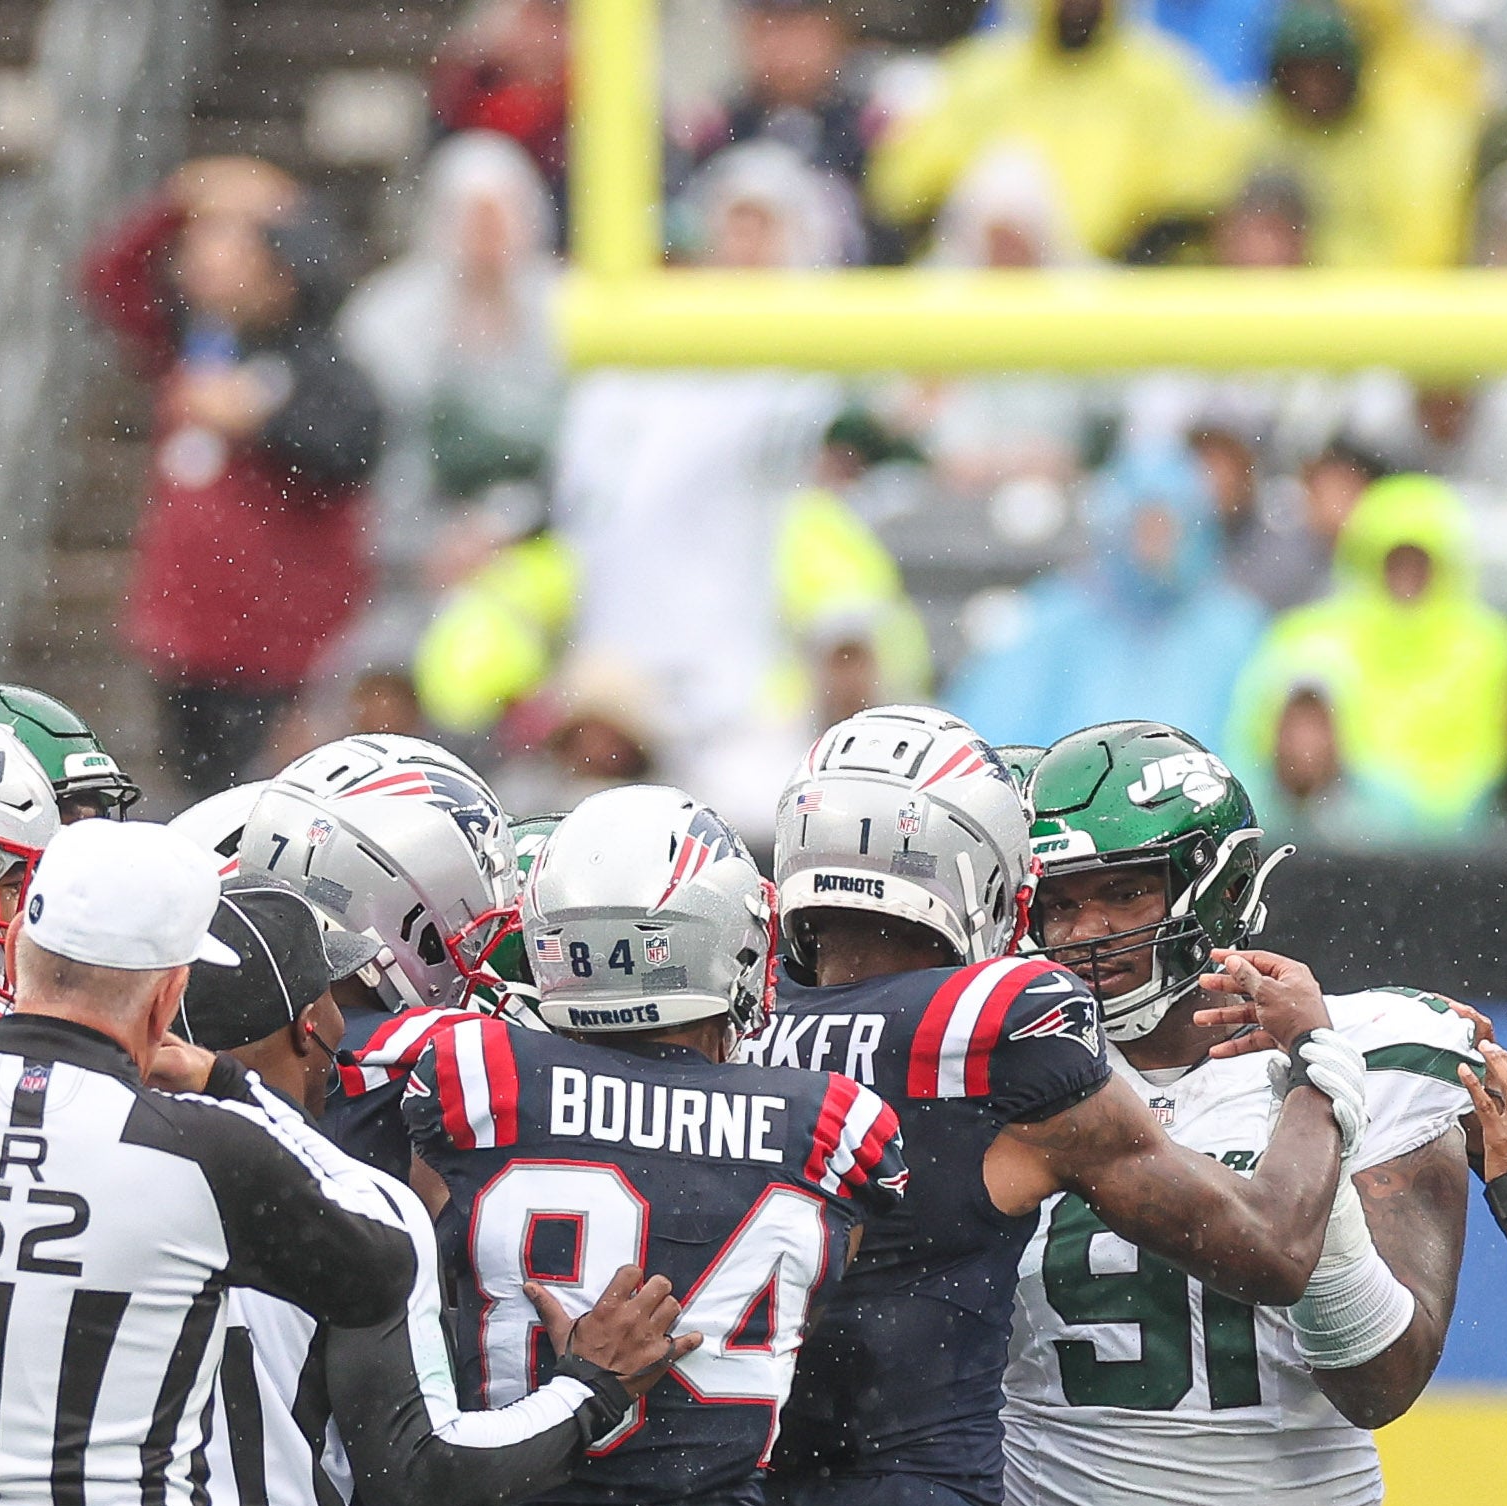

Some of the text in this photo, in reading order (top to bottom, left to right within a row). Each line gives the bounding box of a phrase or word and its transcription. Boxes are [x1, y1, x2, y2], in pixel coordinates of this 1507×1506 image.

[1127, 752, 1232, 805] JETS
[267, 833, 290, 872] 7
[859, 817, 872, 855] 1
[1033, 839, 1070, 854] JETS
[814, 874, 884, 899] PATRIOTS
[568, 1003, 660, 1026] PATRIOTS
[550, 1066, 785, 1163] BOURNE
[469, 1158, 829, 1472] 84
[1043, 1191, 1262, 1411] 91
